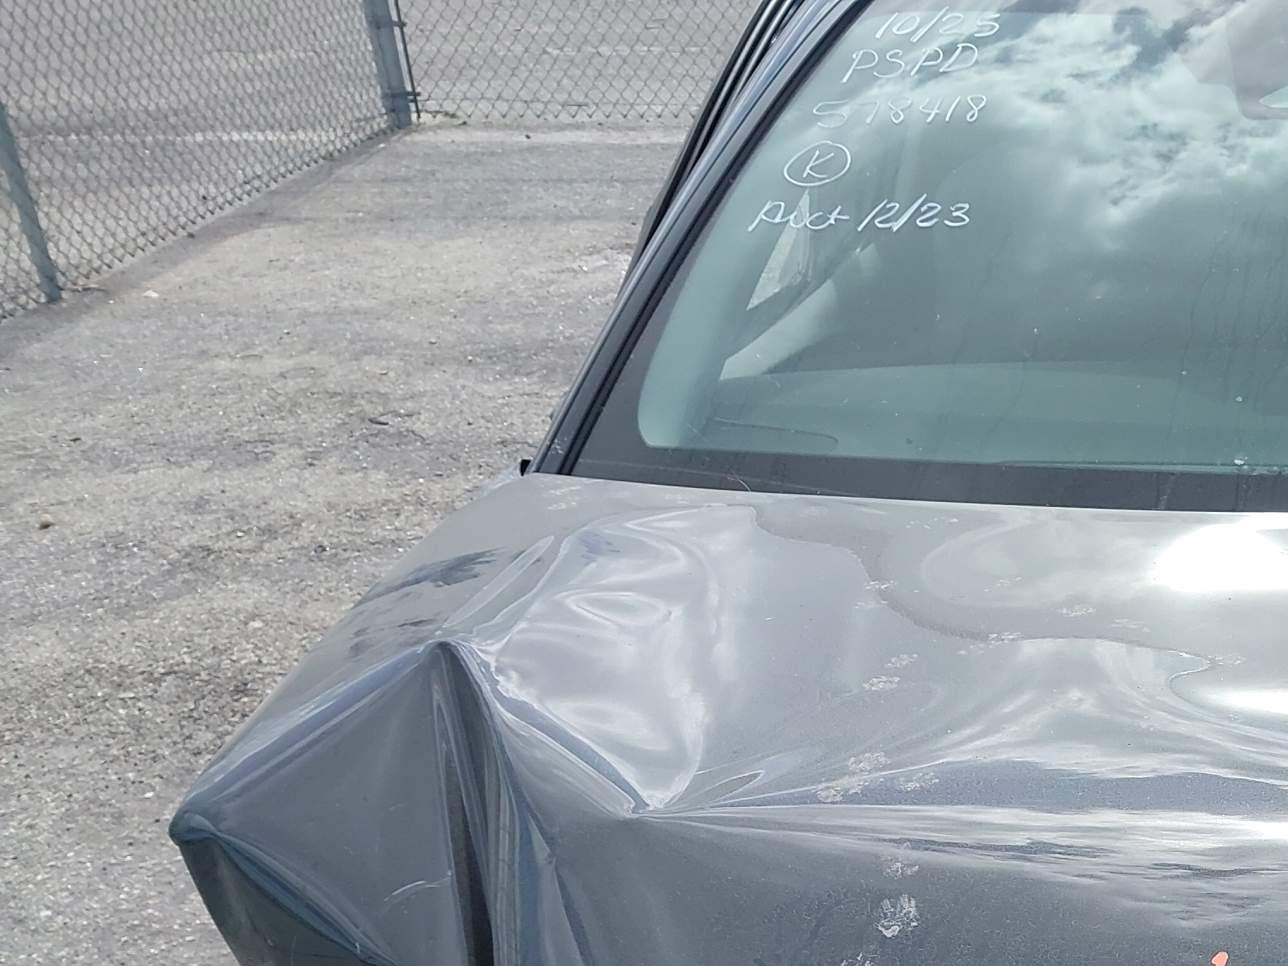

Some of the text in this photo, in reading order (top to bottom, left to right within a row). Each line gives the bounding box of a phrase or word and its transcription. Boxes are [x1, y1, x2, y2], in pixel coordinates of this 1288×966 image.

[875, 6, 1001, 43] 10/25
[840, 43, 978, 83] PSPD
[813, 94, 987, 128] 578418
[857, 193, 970, 232] 12/23
